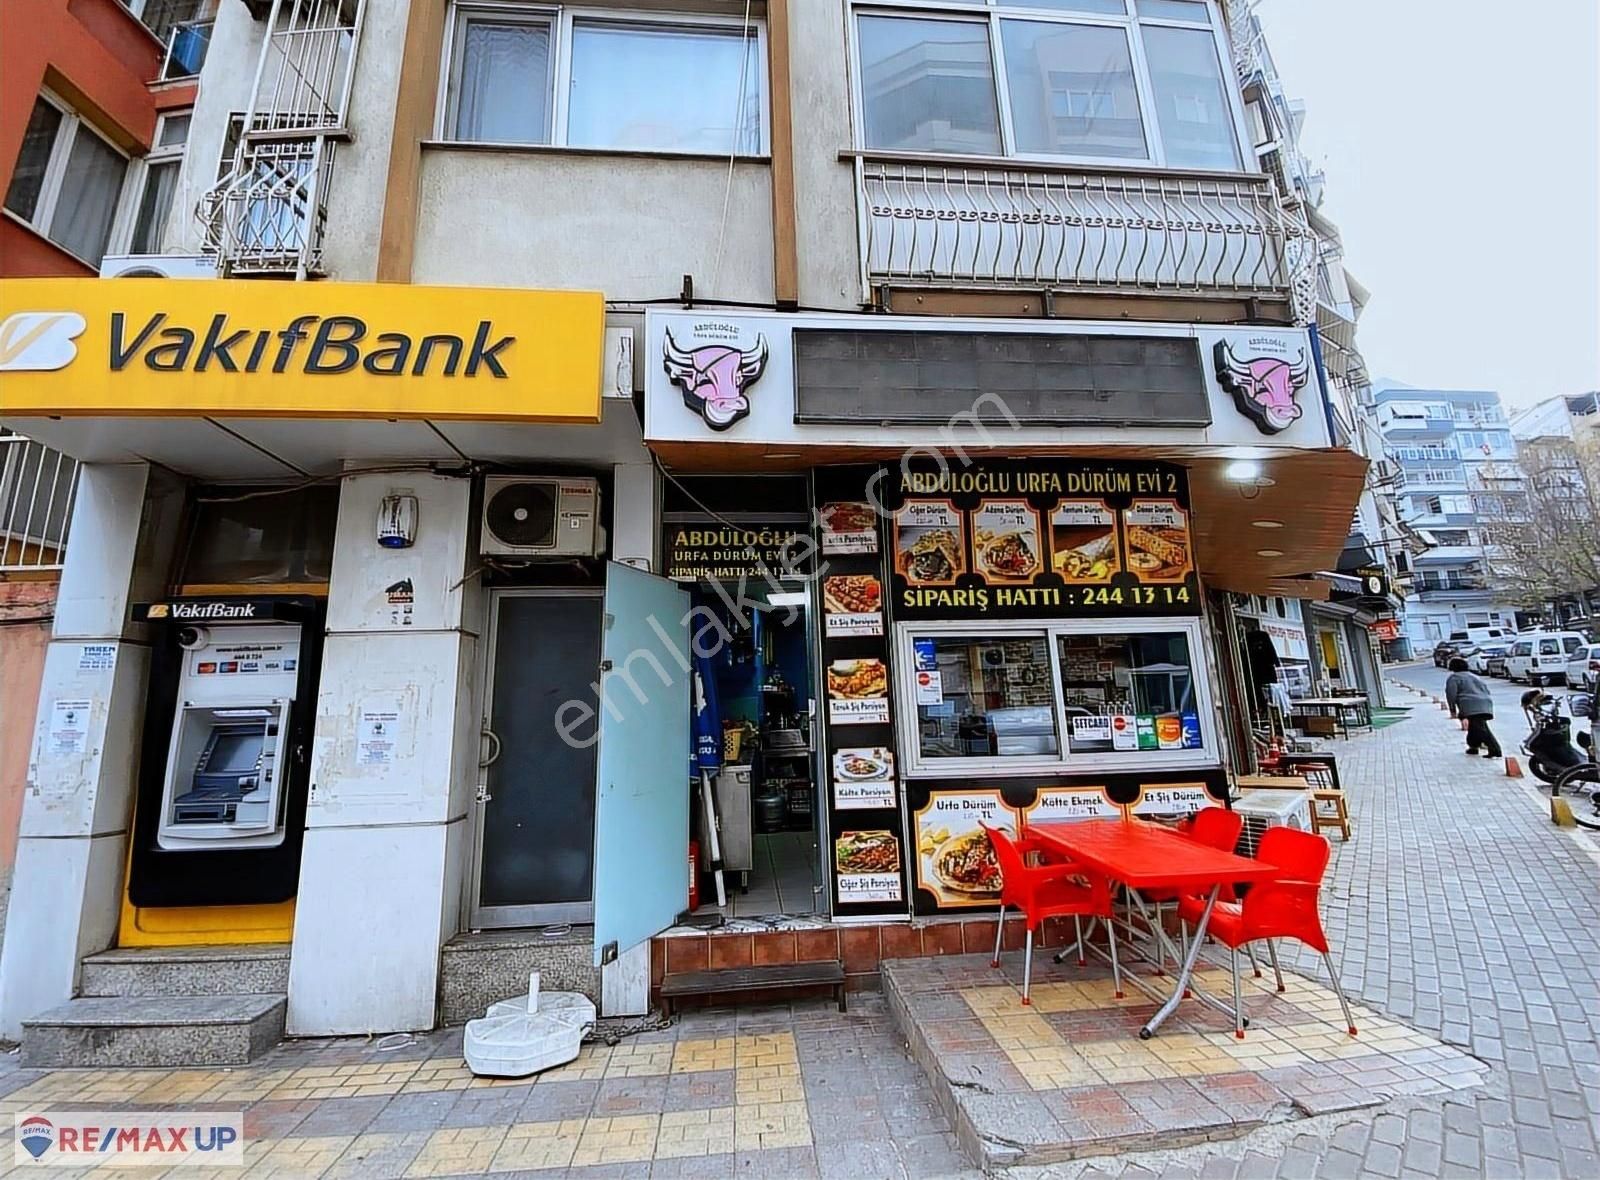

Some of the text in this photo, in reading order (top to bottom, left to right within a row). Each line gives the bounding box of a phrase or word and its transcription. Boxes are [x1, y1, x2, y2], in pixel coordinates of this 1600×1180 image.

[109, 313, 516, 378] VakıfBank
[900, 467, 1177, 493] ABDÜLOĞLU URFA DÜRÜM EVİ 2
[927, 505, 947, 514] Dürüm
[1005, 505, 1025, 514] Dürüm
[1084, 505, 1103, 514] Dürüm
[939, 516, 948, 525] TL
[1015, 516, 1025, 525] TL
[1093, 515, 1102, 524] TL
[1165, 515, 1174, 524] TL
[674, 526, 797, 546] ABDÜLOĞLU
[674, 550, 709, 561] URFA
[714, 566, 745, 577] HATTI
[903, 585, 988, 612] SİPARİŞ
[997, 588, 1060, 606] HATTI
[1082, 587, 1124, 605] 244
[1131, 587, 1155, 605] 13
[1163, 586, 1190, 604] 14
[172, 603, 255, 618] VakıfBank
[830, 618, 838, 626] Et
[1074, 718, 1109, 729] SETCARD
[1041, 795, 1104, 808] Köfte Ekmek
[1144, 791, 1205, 804] Et Şiş Dürüm
[936, 799, 997, 811] Urfa Dürüm
[1189, 802, 1200, 811] TL
[981, 810, 993, 819] TL
[1087, 806, 1099, 815] TL
[888, 891, 897, 899] TL
